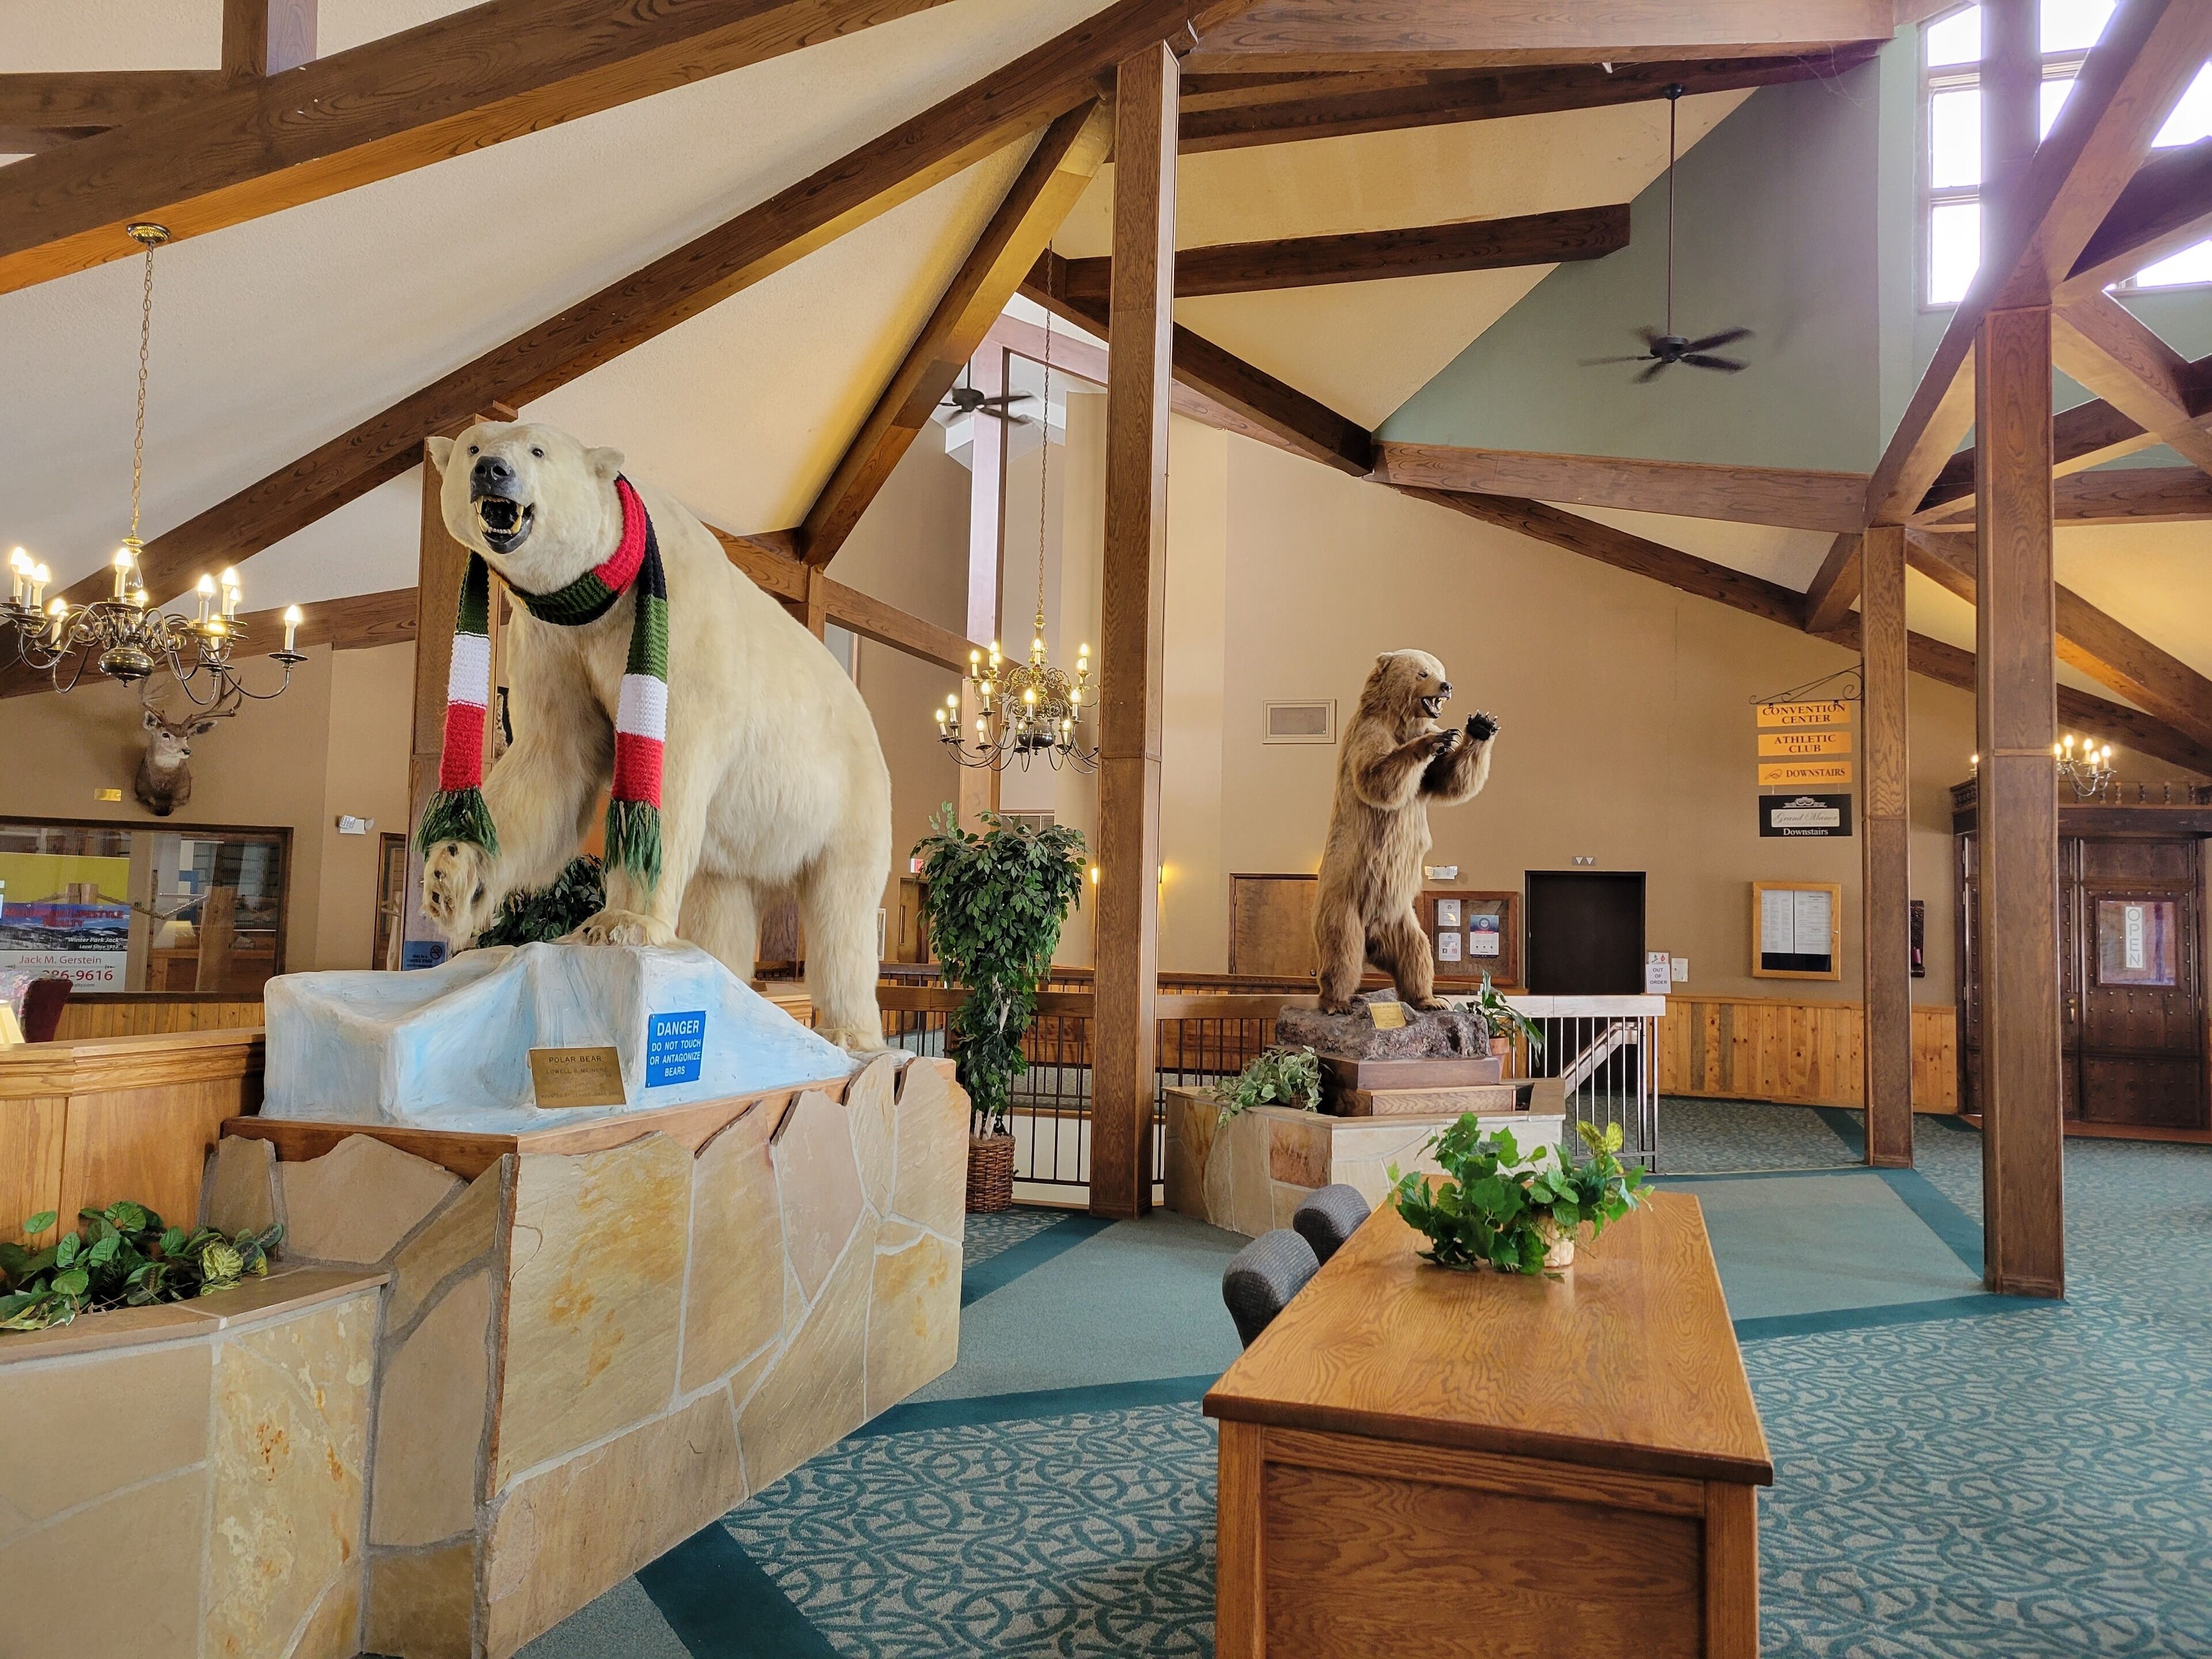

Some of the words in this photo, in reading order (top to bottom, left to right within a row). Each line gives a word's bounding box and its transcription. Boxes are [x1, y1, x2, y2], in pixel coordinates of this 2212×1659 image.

[1763, 704, 1845, 715] CONVENTION
[1782, 714, 1831, 724] CENTER
[1774, 734, 1836, 744] ATHLETIC
[1789, 744, 1821, 753] CLUB
[1786, 768, 1846, 778] DOWNSTAIRS
[1775, 811, 1804, 824] Grand
[2127, 908, 2141, 967] OPEN
[20, 956, 41, 964] Jack
[60, 956, 101, 964] Gerstein
[657, 1020, 699, 1036] DANGER
[652, 1042, 662, 1052] DO
[665, 1041, 679, 1050] NOT
[681, 1039, 701, 1049] TOUCH
[650, 1056, 660, 1065] OR
[662, 1051, 701, 1064] ANTAGONIZE
[664, 1066, 685, 1077] BEARS
